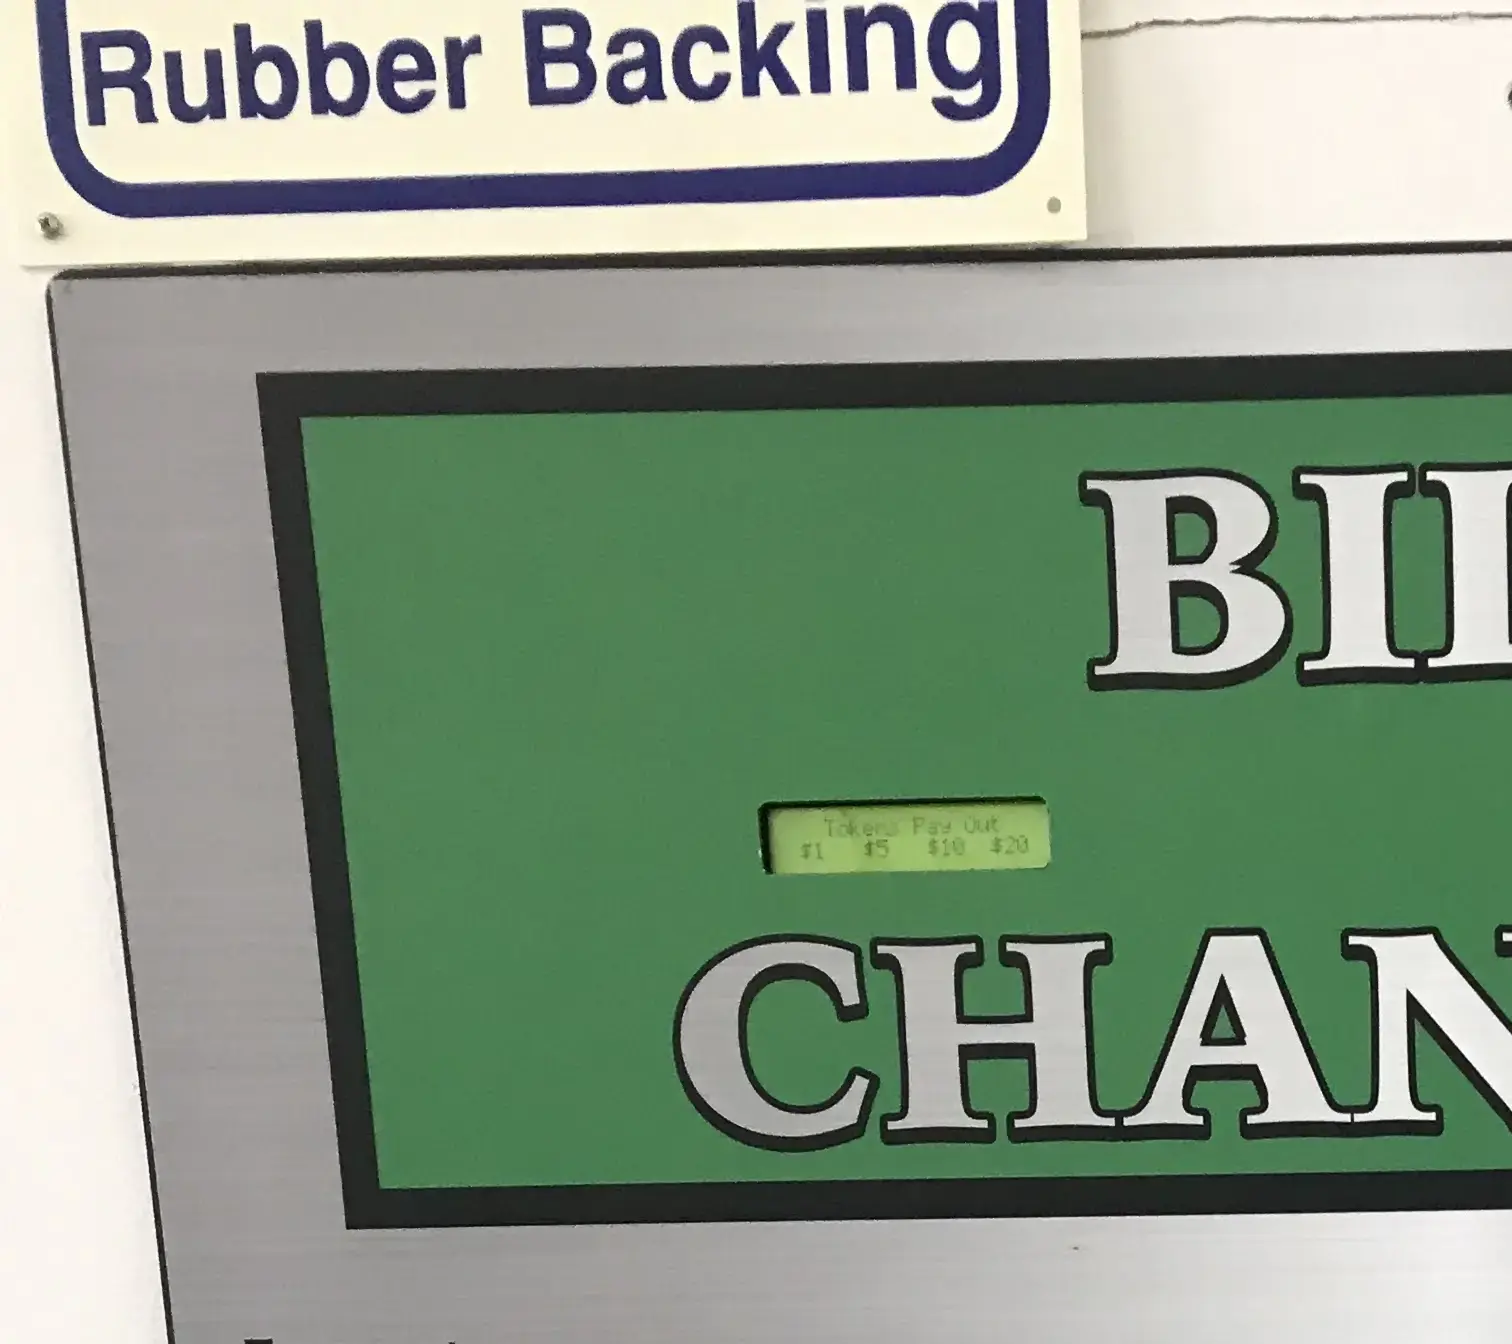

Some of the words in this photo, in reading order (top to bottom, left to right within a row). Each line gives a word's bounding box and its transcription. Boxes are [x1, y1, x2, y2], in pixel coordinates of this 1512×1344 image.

[81, 24, 483, 127] Rubber
[522, 0, 1003, 122] Backing
[864, 838, 889, 858] $5
[928, 837, 966, 857] $10
[990, 835, 1030, 855] $20
